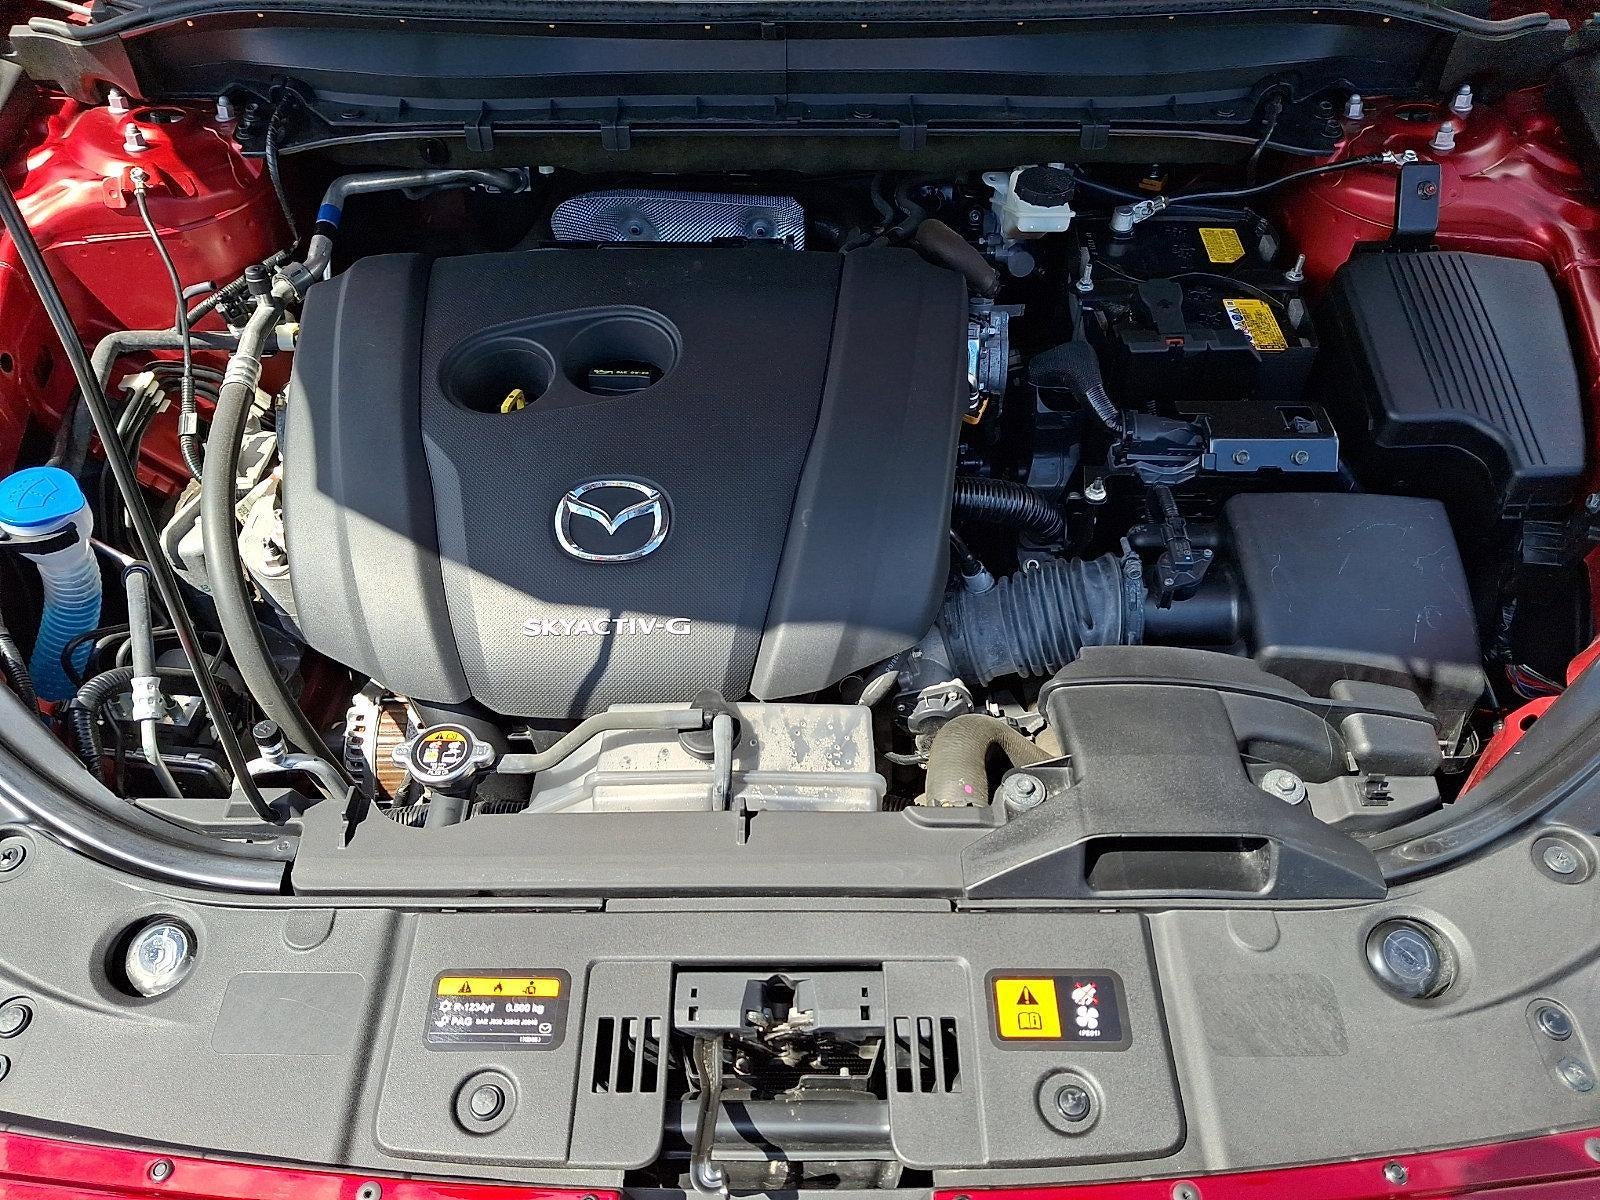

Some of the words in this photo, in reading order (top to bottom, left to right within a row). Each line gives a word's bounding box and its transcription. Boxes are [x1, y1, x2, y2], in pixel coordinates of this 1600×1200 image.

[523, 617, 692, 637] SKYACTIV-G
[531, 1002, 545, 1015] kg
[450, 1016, 472, 1027] PAG
